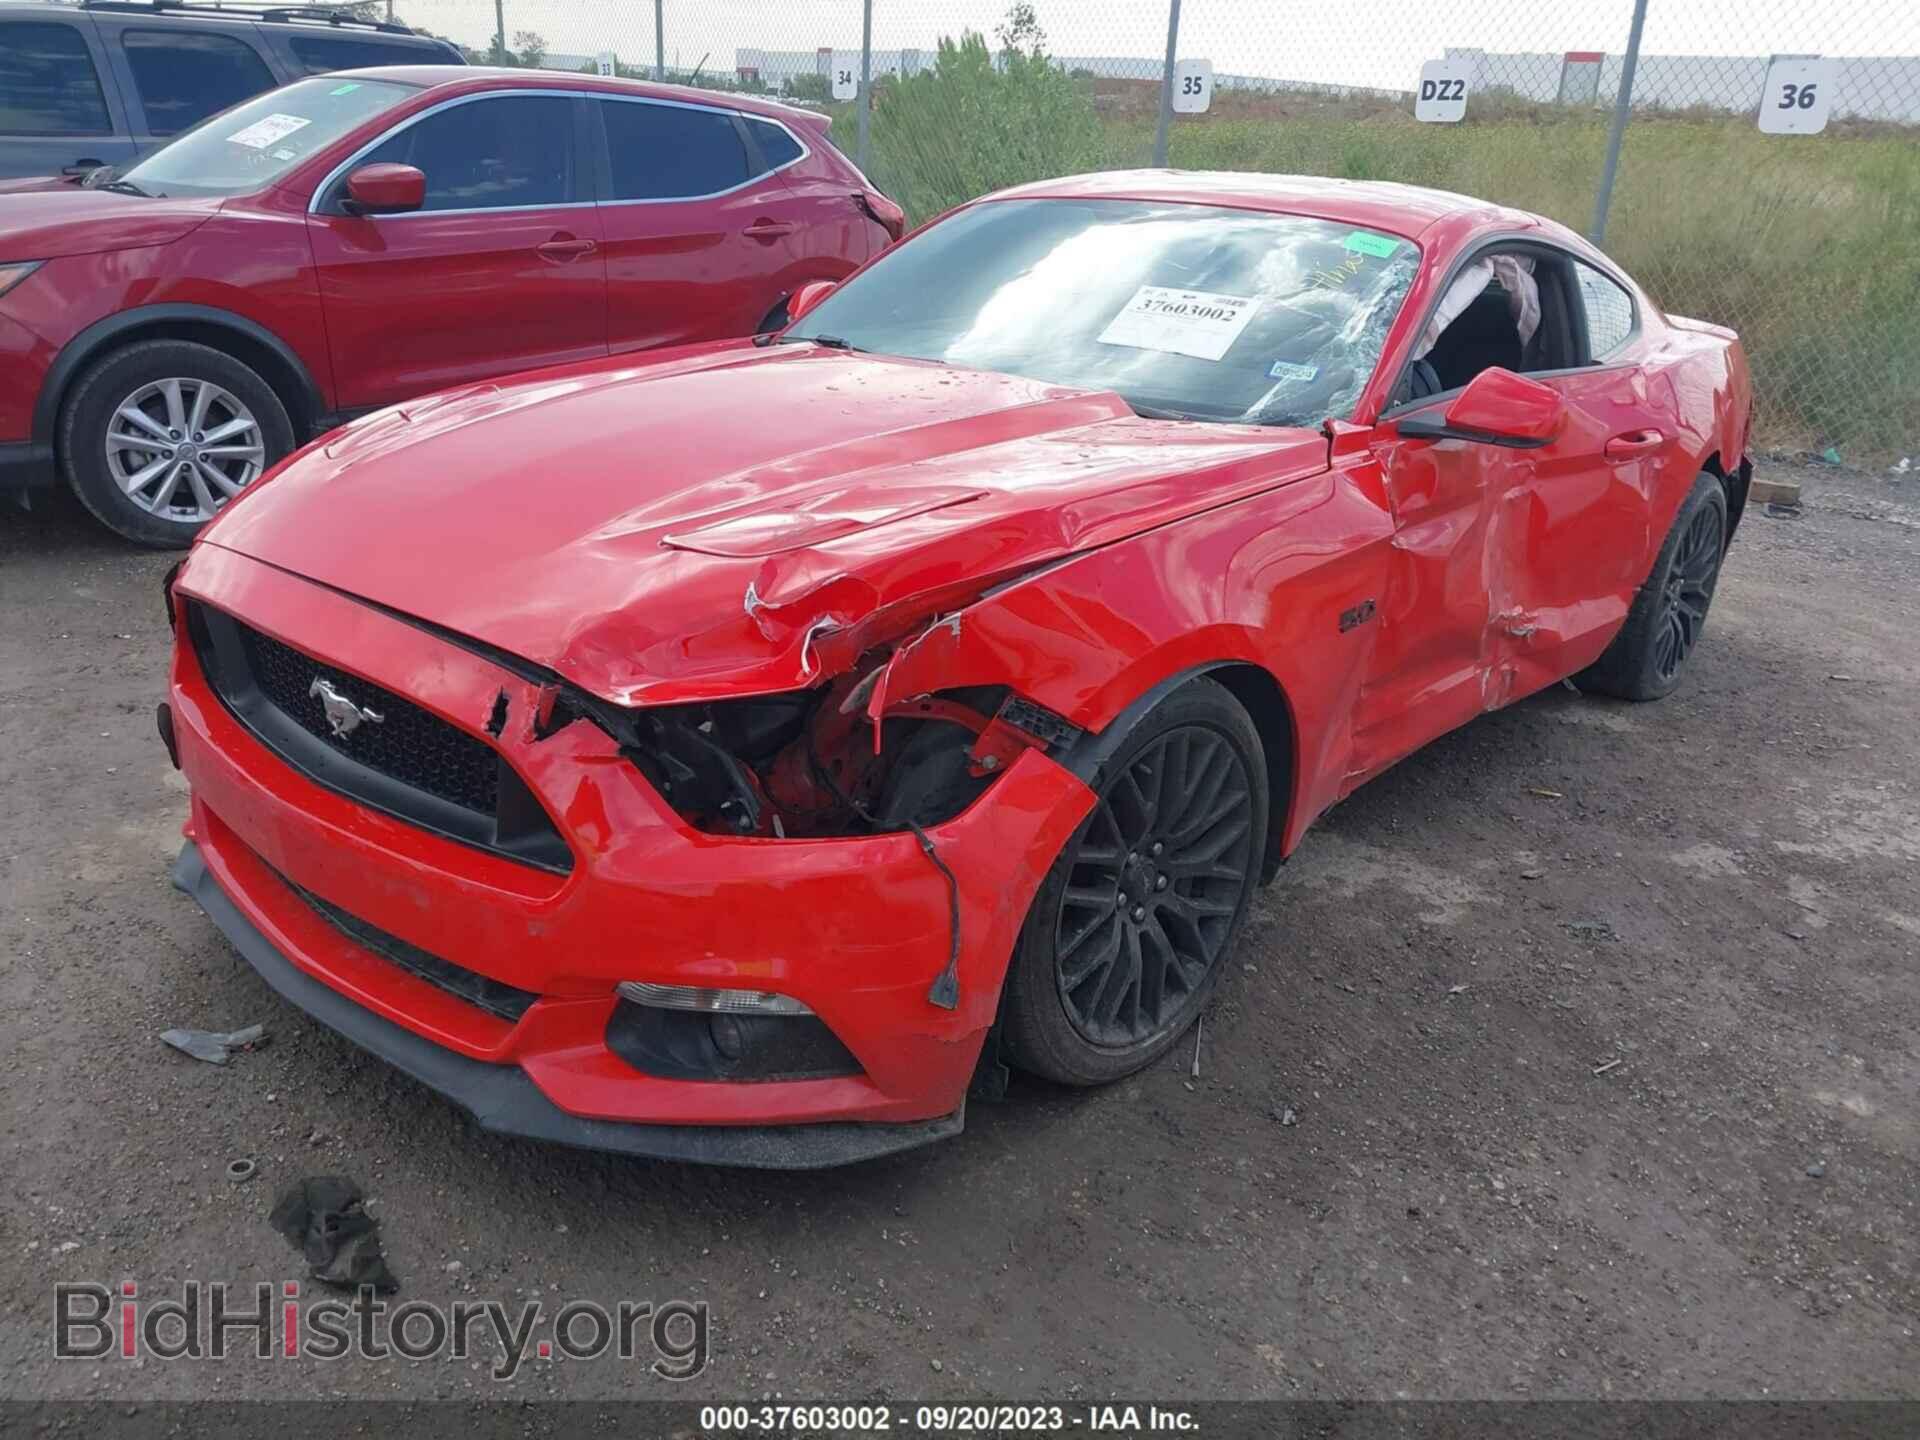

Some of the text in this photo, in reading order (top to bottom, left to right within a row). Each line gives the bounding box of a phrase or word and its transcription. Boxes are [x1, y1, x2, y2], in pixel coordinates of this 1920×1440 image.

[838, 70, 851, 85] 34
[1182, 76, 1202, 95] 35
[1421, 79, 1465, 101] DZ2
[1778, 84, 1816, 109] 36
[1137, 299, 1236, 322] 37603002
